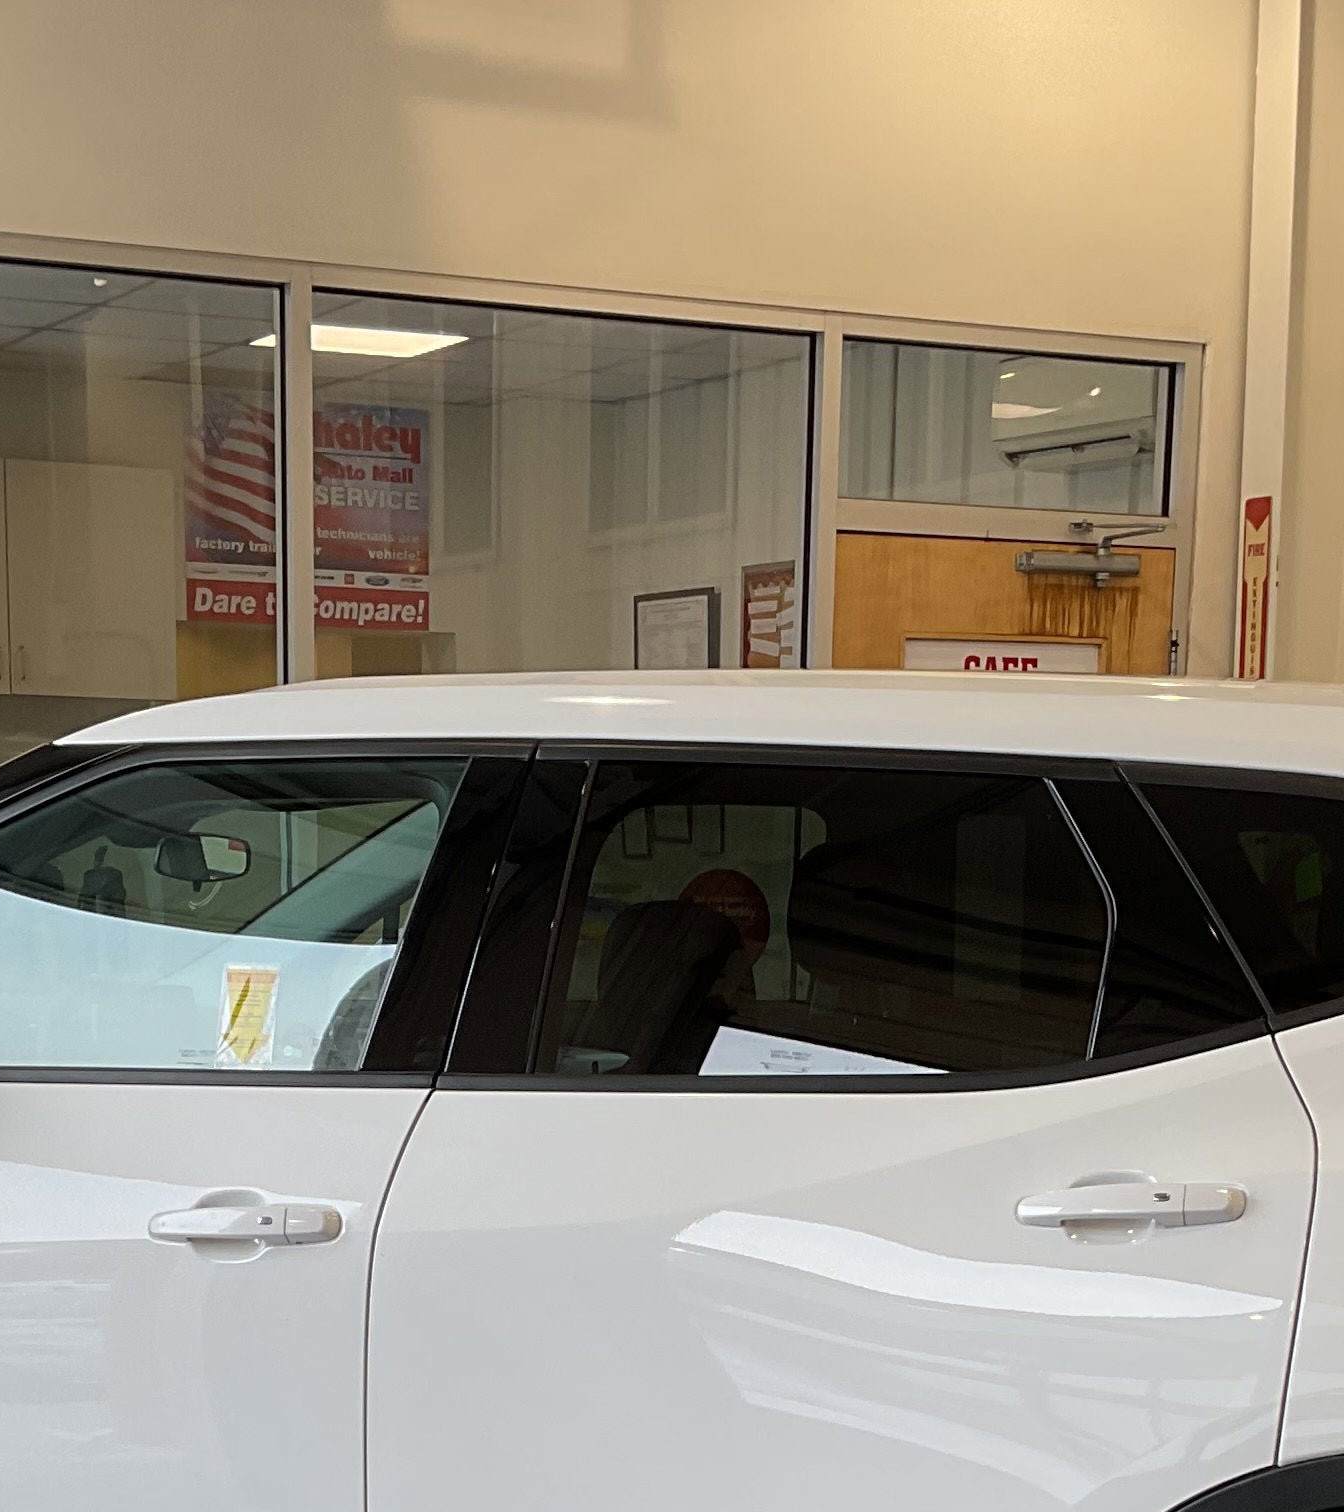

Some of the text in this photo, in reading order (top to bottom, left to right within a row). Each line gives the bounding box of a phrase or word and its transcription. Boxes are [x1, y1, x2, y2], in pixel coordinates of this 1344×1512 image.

[372, 465, 413, 484] Mall
[314, 484, 420, 511] SERVICE
[316, 527, 394, 542] technicians
[195, 536, 245, 553] factory
[368, 548, 421, 561] vehicle!
[1247, 543, 1265, 557] FIRE
[194, 587, 257, 615] Dare
[265, 592, 276, 616] t
